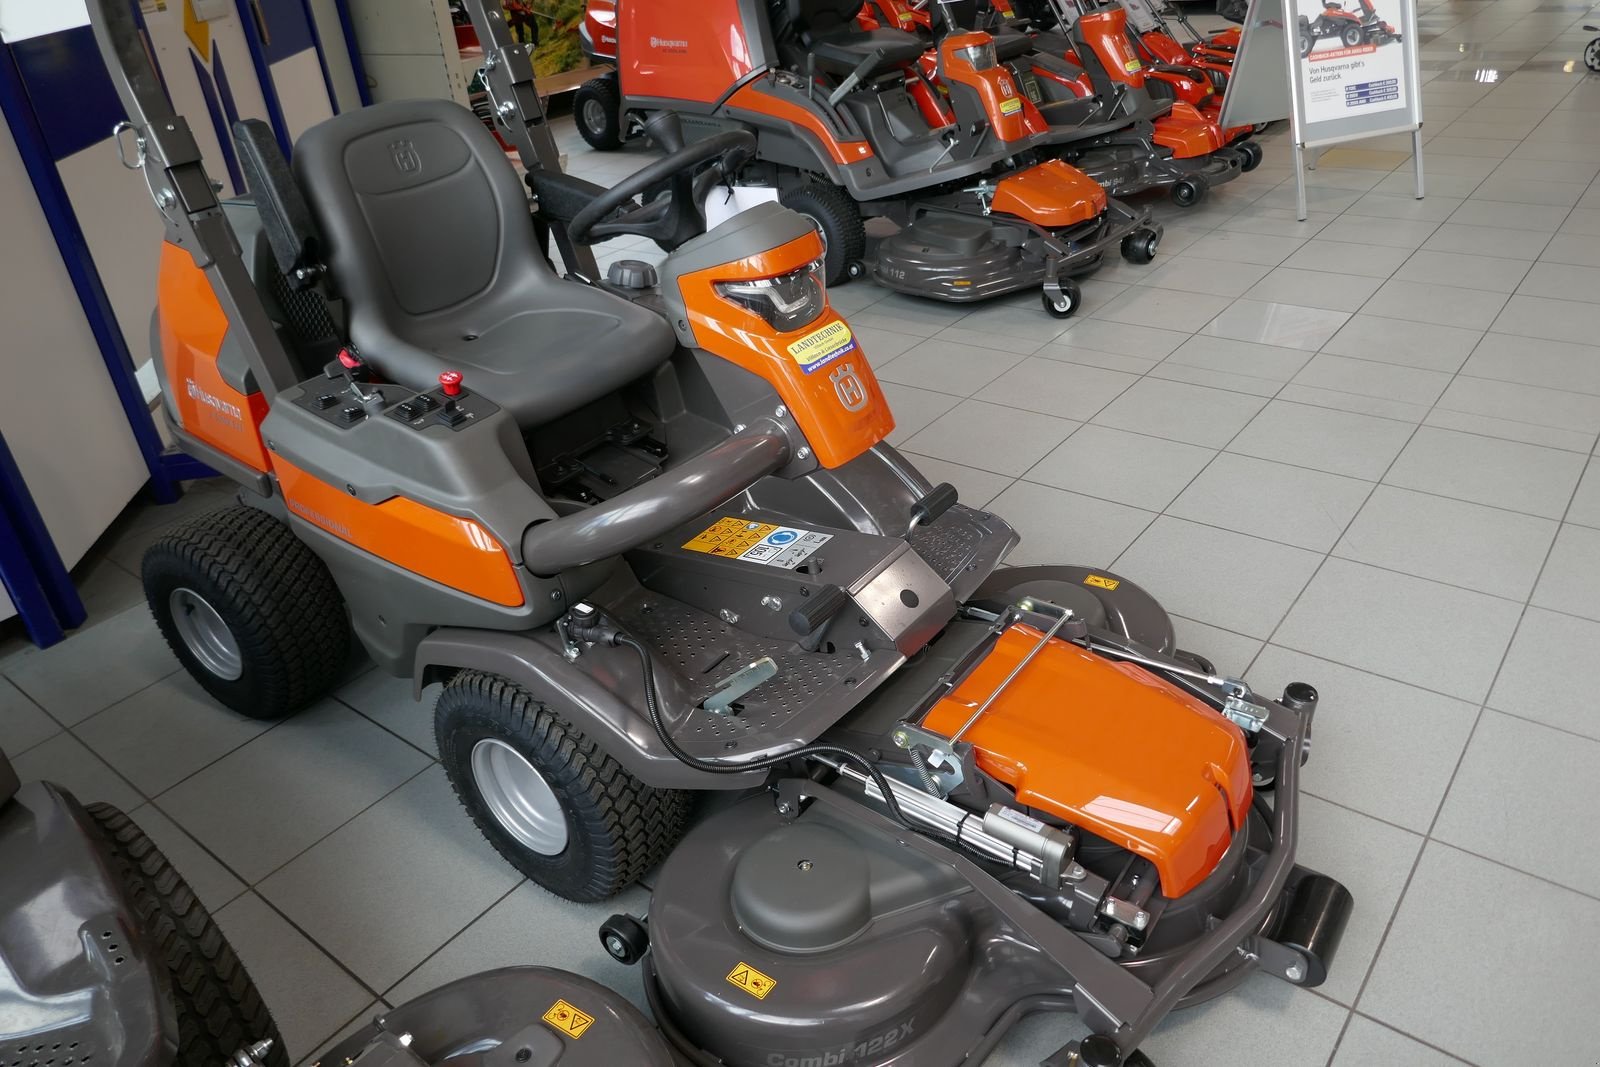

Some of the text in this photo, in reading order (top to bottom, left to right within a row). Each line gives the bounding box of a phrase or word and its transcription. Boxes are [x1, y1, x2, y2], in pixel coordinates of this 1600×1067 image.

[1309, 66, 1320, 74] Von
[1320, 62, 1349, 74] Husqvarna
[1309, 74, 1322, 83] Geld
[791, 322, 844, 355] LANDTECHNIK
[288, 498, 353, 538] PROFESSIONAL
[767, 1048, 846, 1067] Combi
